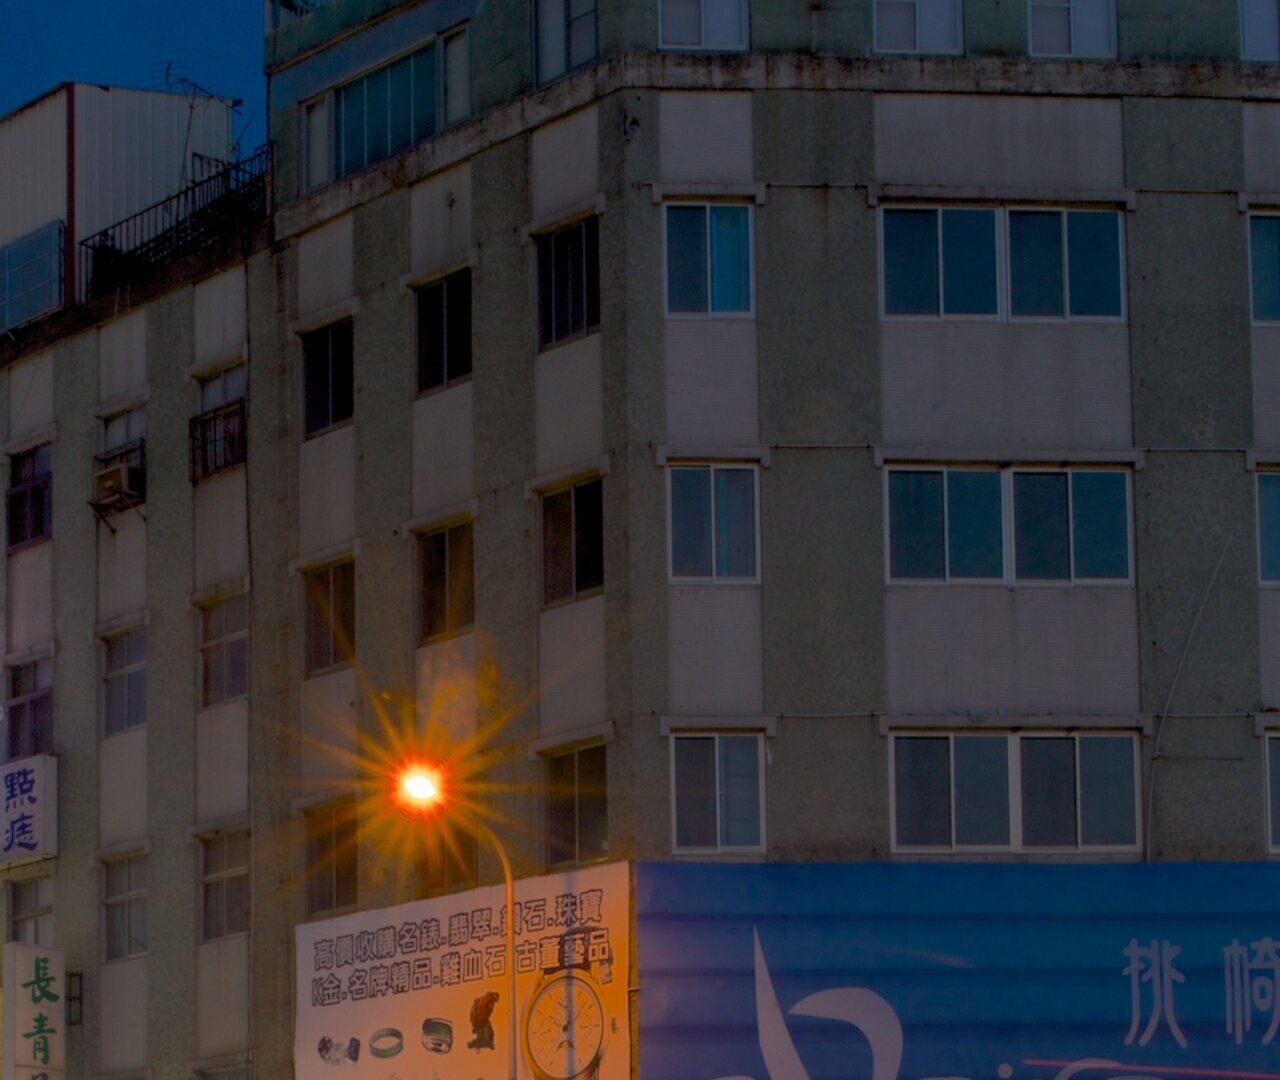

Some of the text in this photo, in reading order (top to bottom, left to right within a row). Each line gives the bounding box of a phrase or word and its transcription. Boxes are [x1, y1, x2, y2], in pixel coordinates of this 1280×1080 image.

[4, 767, 39, 853] 點痣
[517, 927, 609, 974] 古董藝品
